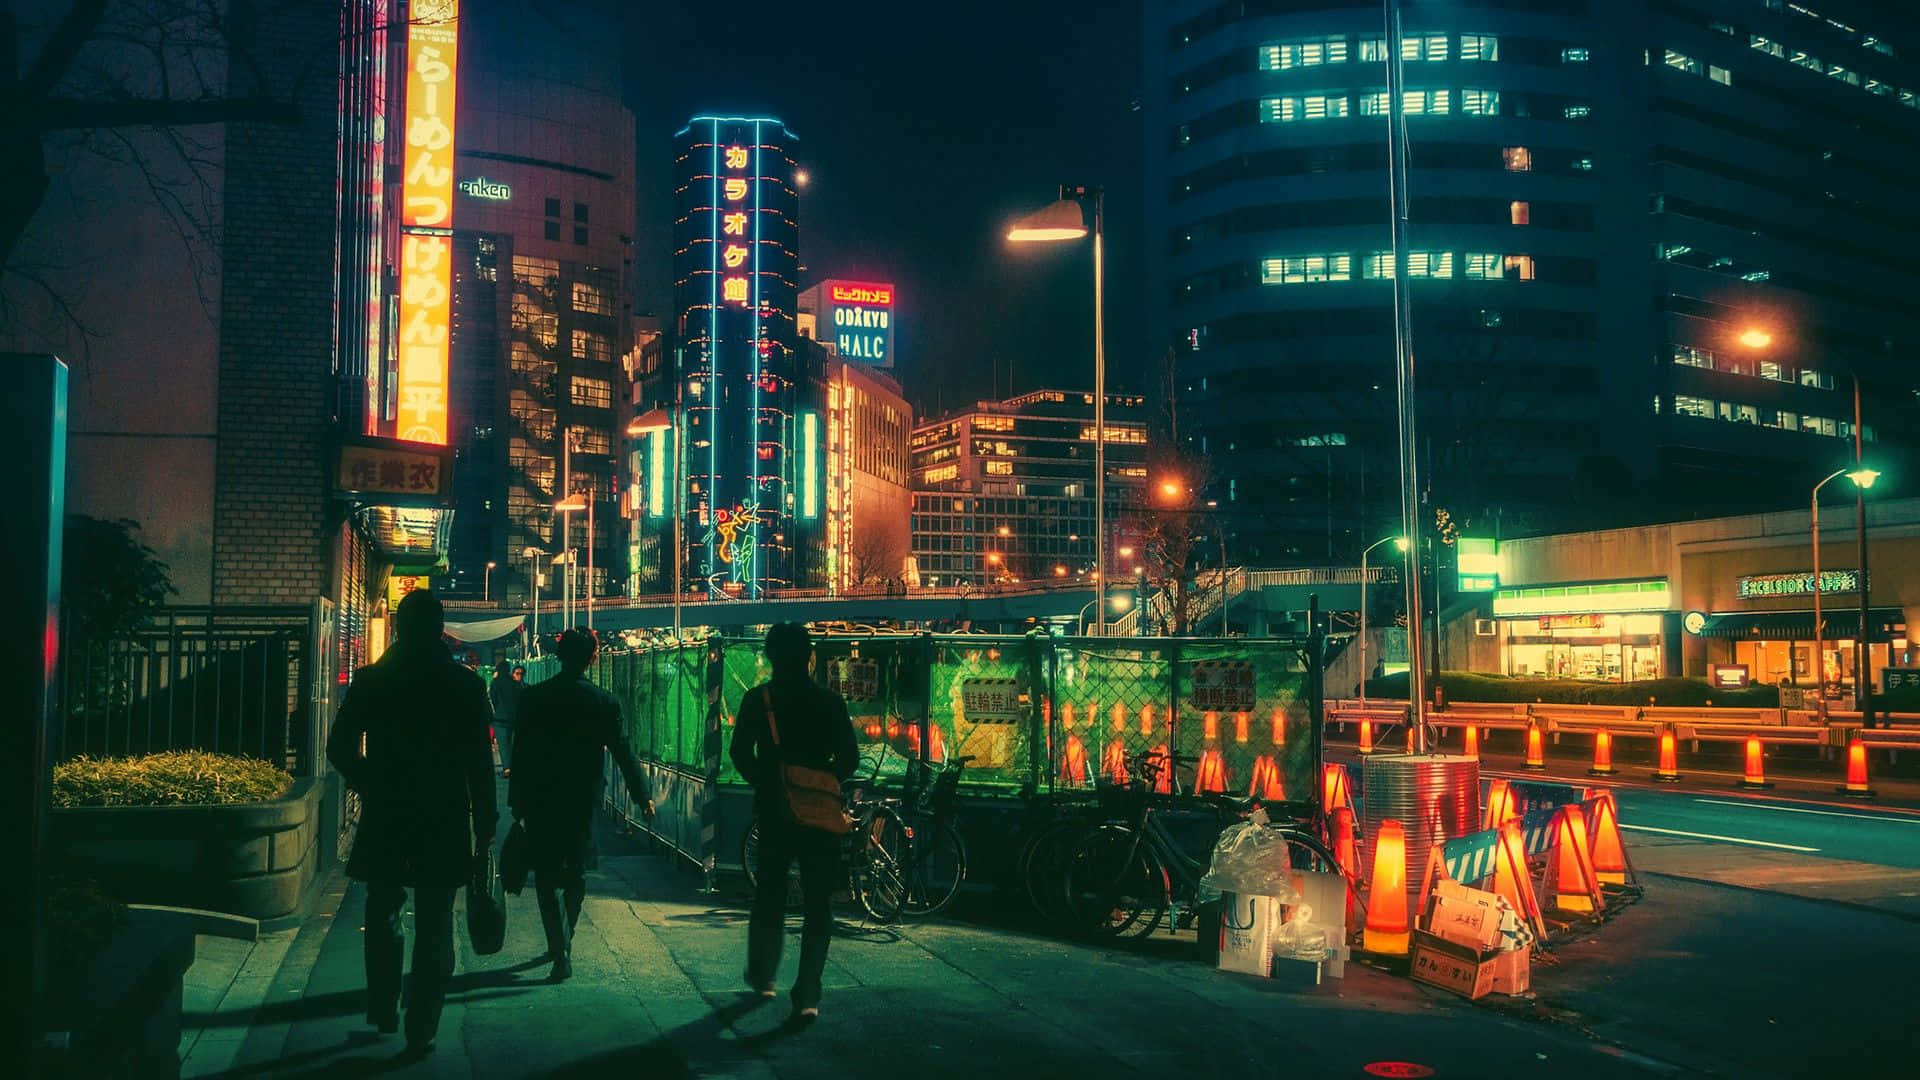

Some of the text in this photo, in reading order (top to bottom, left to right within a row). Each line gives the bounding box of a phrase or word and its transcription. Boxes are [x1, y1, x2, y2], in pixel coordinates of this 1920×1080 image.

[724, 147, 748, 301] カラオケ館
[833, 287, 890, 304] ビックカメラ
[840, 334, 884, 358] HALC
[1741, 578, 1805, 596] EXCELSIOR
[965, 692, 1016, 712] 駐輪禁止
